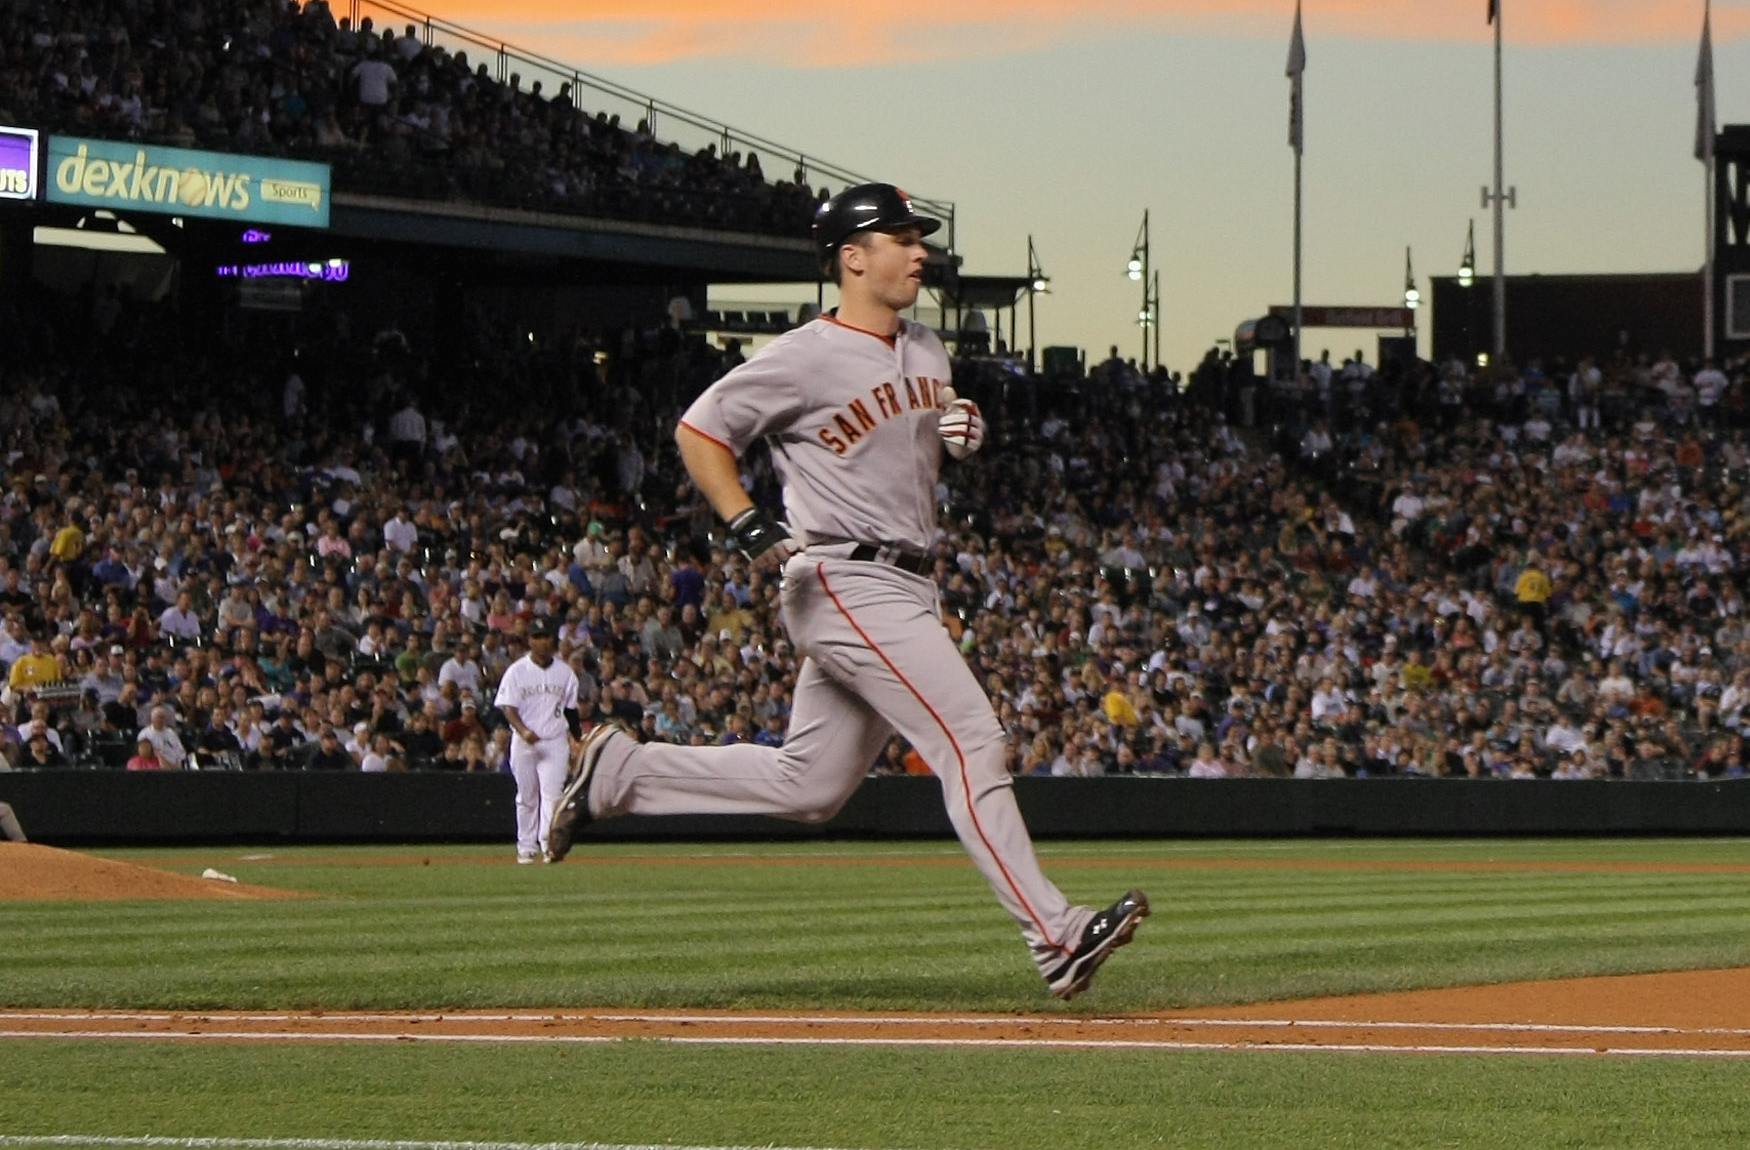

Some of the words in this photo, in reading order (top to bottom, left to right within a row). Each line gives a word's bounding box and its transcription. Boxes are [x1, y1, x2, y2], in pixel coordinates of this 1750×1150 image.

[272, 183, 308, 199] Sports
[818, 397, 877, 455] SAN
[553, 700, 563, 719] 6
